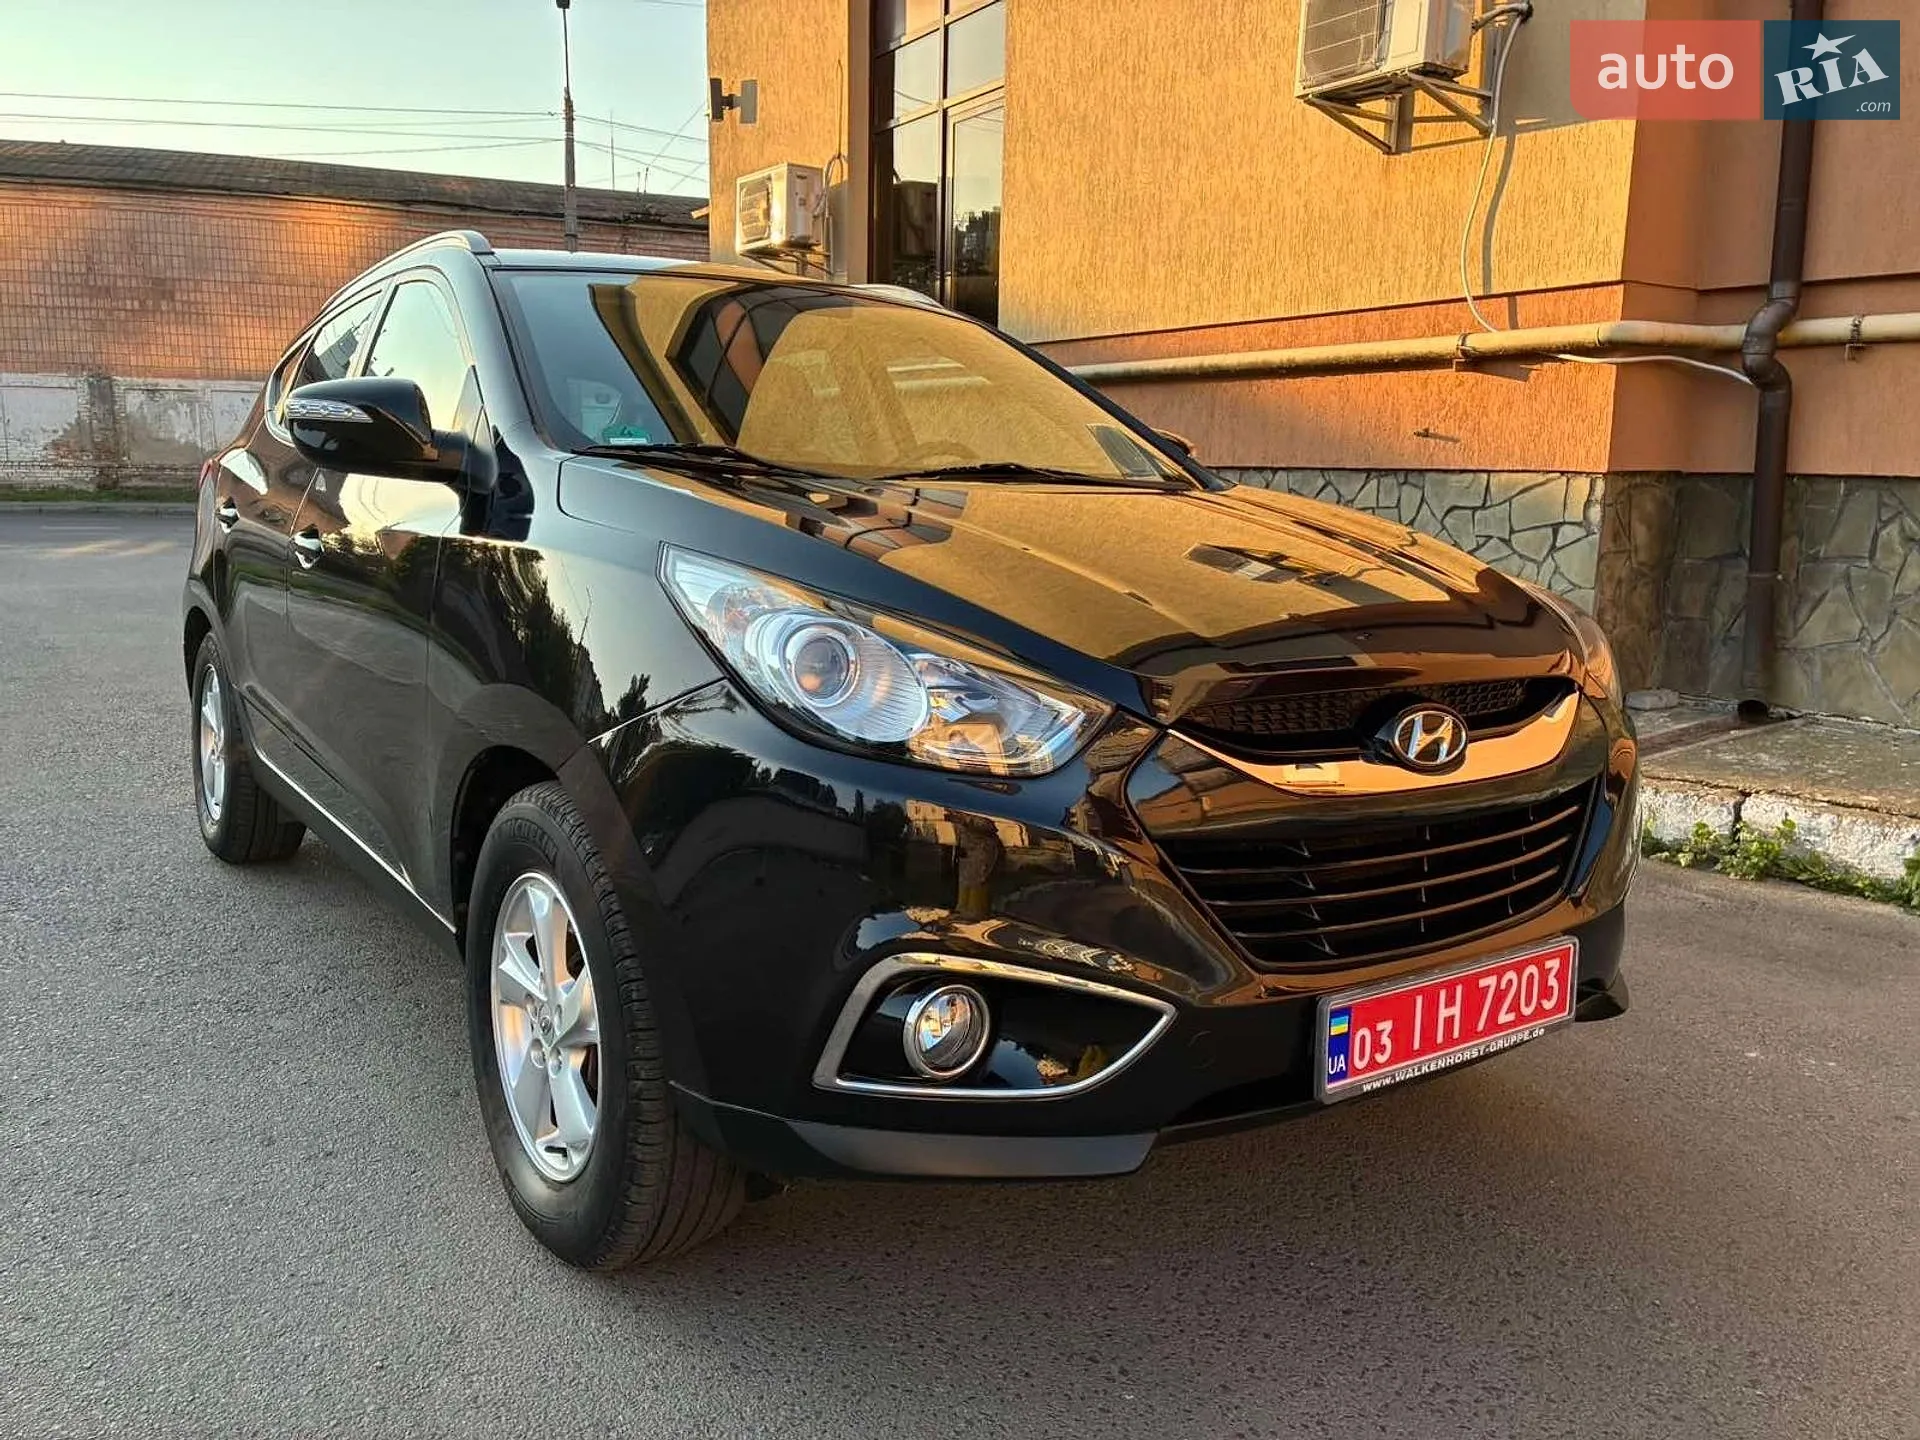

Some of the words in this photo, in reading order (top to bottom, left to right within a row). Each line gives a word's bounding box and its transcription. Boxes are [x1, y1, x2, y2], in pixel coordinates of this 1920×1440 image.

[1353, 1019, 1393, 1070] 03
[1412, 983, 1463, 1050] IH
[1477, 959, 1560, 1032] 7203
[1328, 1053, 1346, 1075] UA
